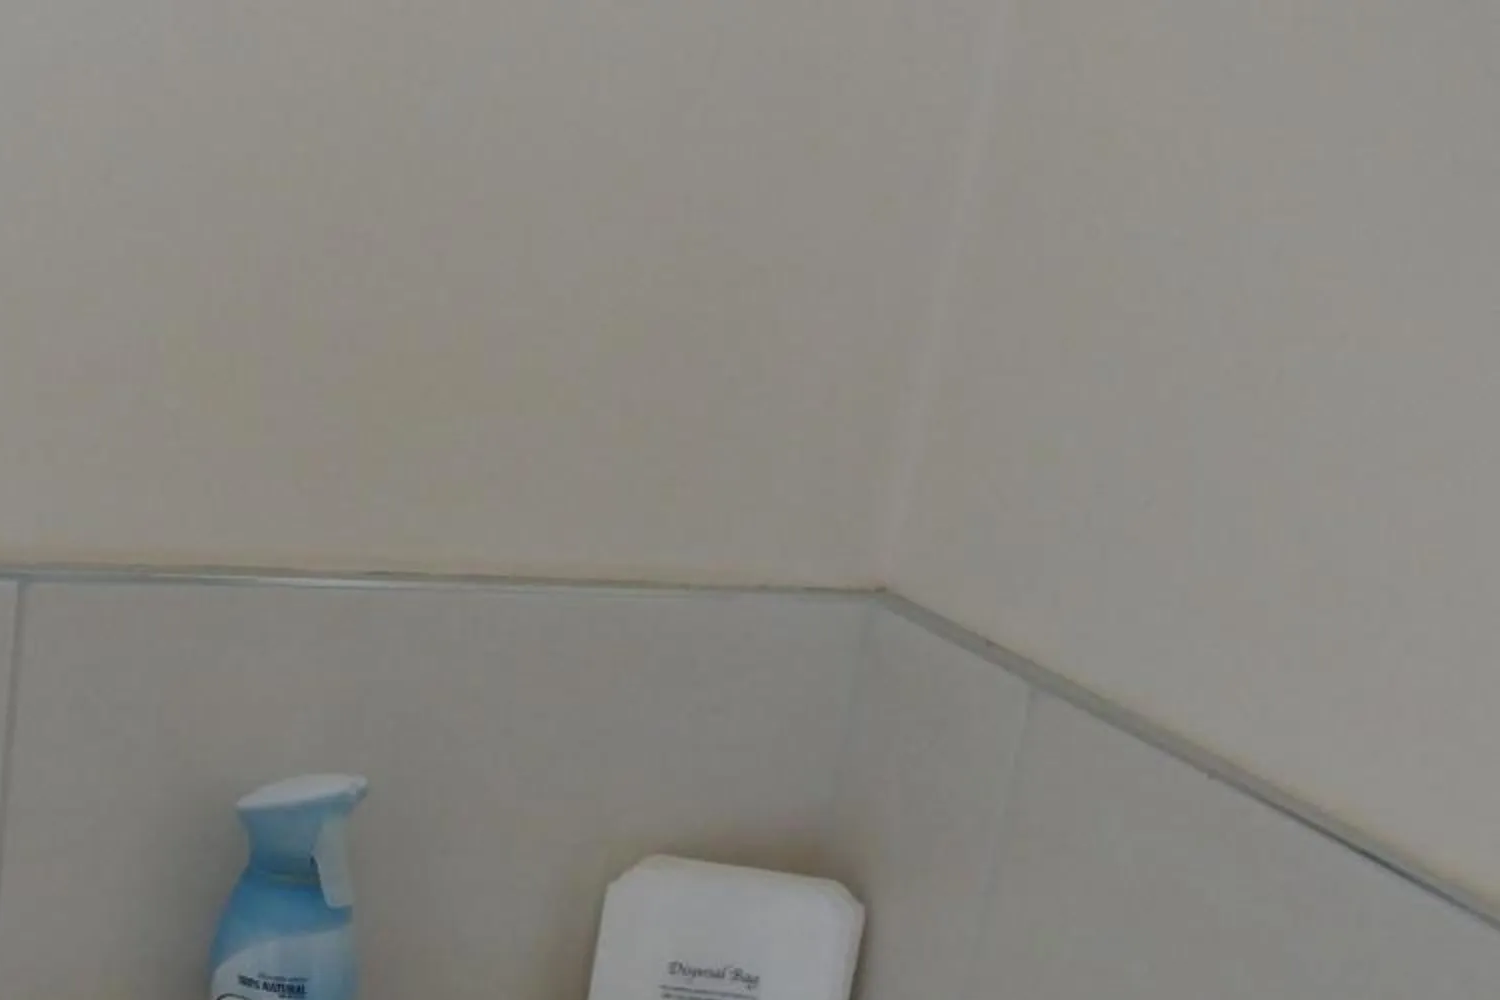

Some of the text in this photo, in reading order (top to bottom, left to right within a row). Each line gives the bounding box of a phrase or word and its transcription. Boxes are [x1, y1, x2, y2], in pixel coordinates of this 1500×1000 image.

[666, 959, 761, 991] Disposal Bag
[261, 980, 307, 996] NATURAL
